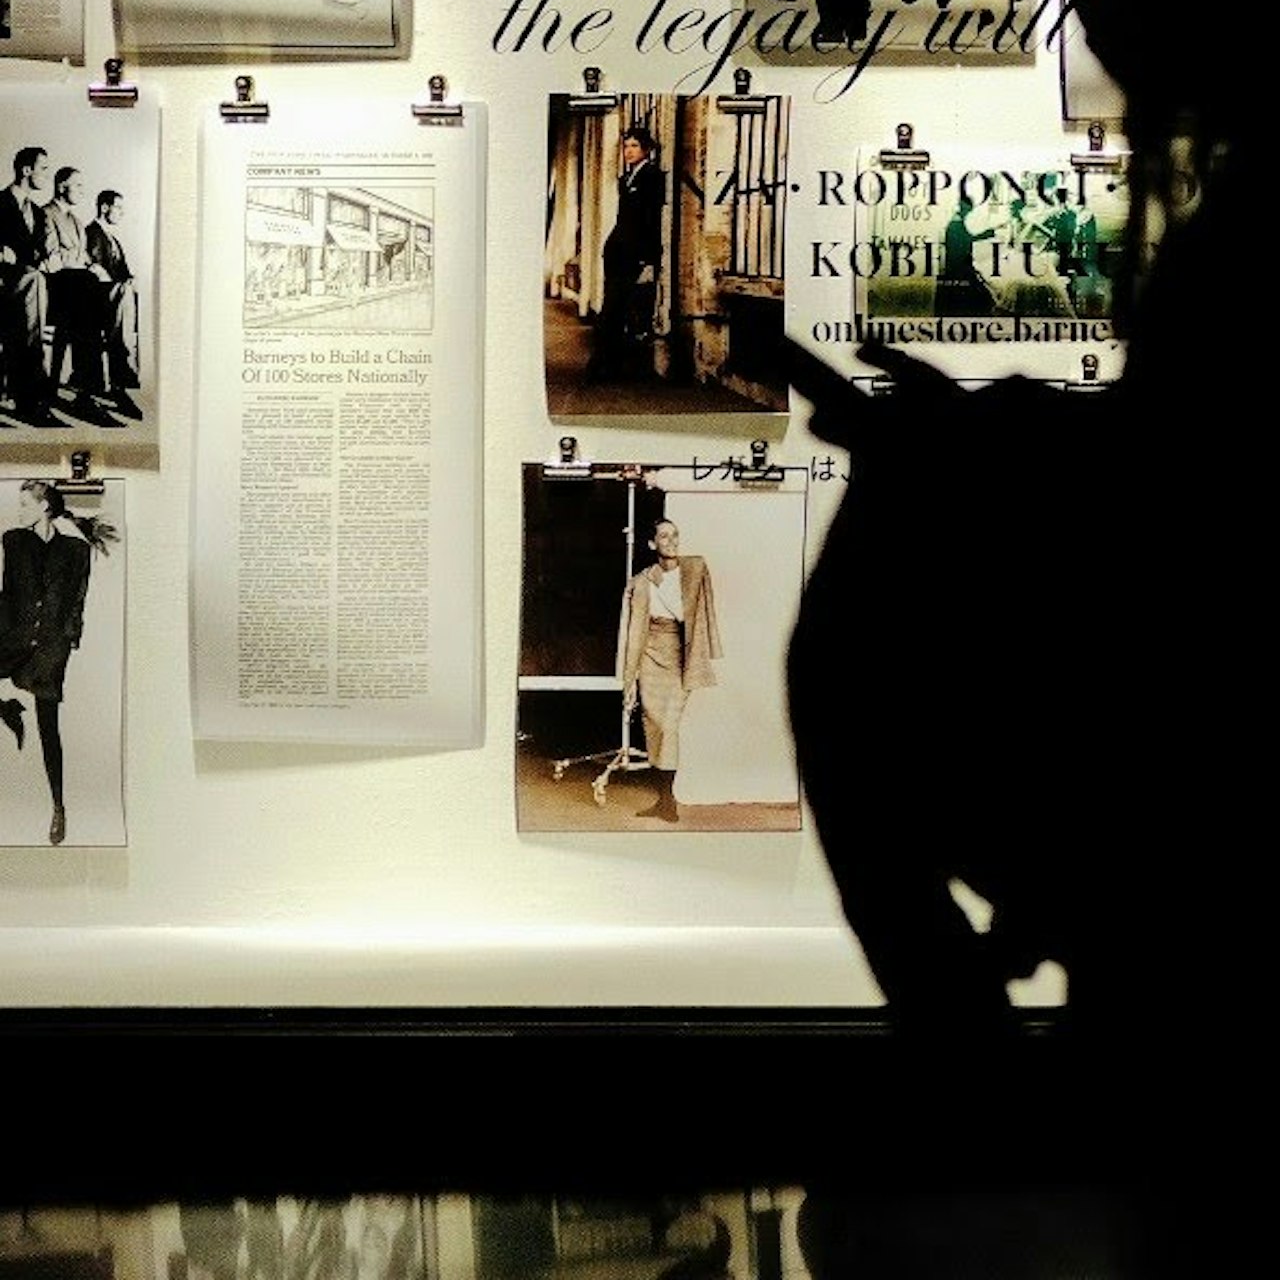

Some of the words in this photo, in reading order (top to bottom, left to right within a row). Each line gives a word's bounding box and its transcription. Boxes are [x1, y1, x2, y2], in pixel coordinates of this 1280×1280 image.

[246, 168, 292, 176] COMPANY
[294, 168, 321, 176] NEWS
[816, 169, 1089, 208] ROPPONGI
[889, 204, 933, 222] DOGS
[812, 313, 1117, 349] onlinestore.barne
[243, 349, 307, 367] Barneys
[310, 350, 325, 364] to
[329, 349, 369, 364] Build
[373, 353, 382, 364] a
[387, 348, 432, 364] Chain
[241, 367, 261, 383] Of
[264, 368, 290, 383] 100
[293, 368, 343, 383] Stores
[347, 368, 428, 386] Nationally
